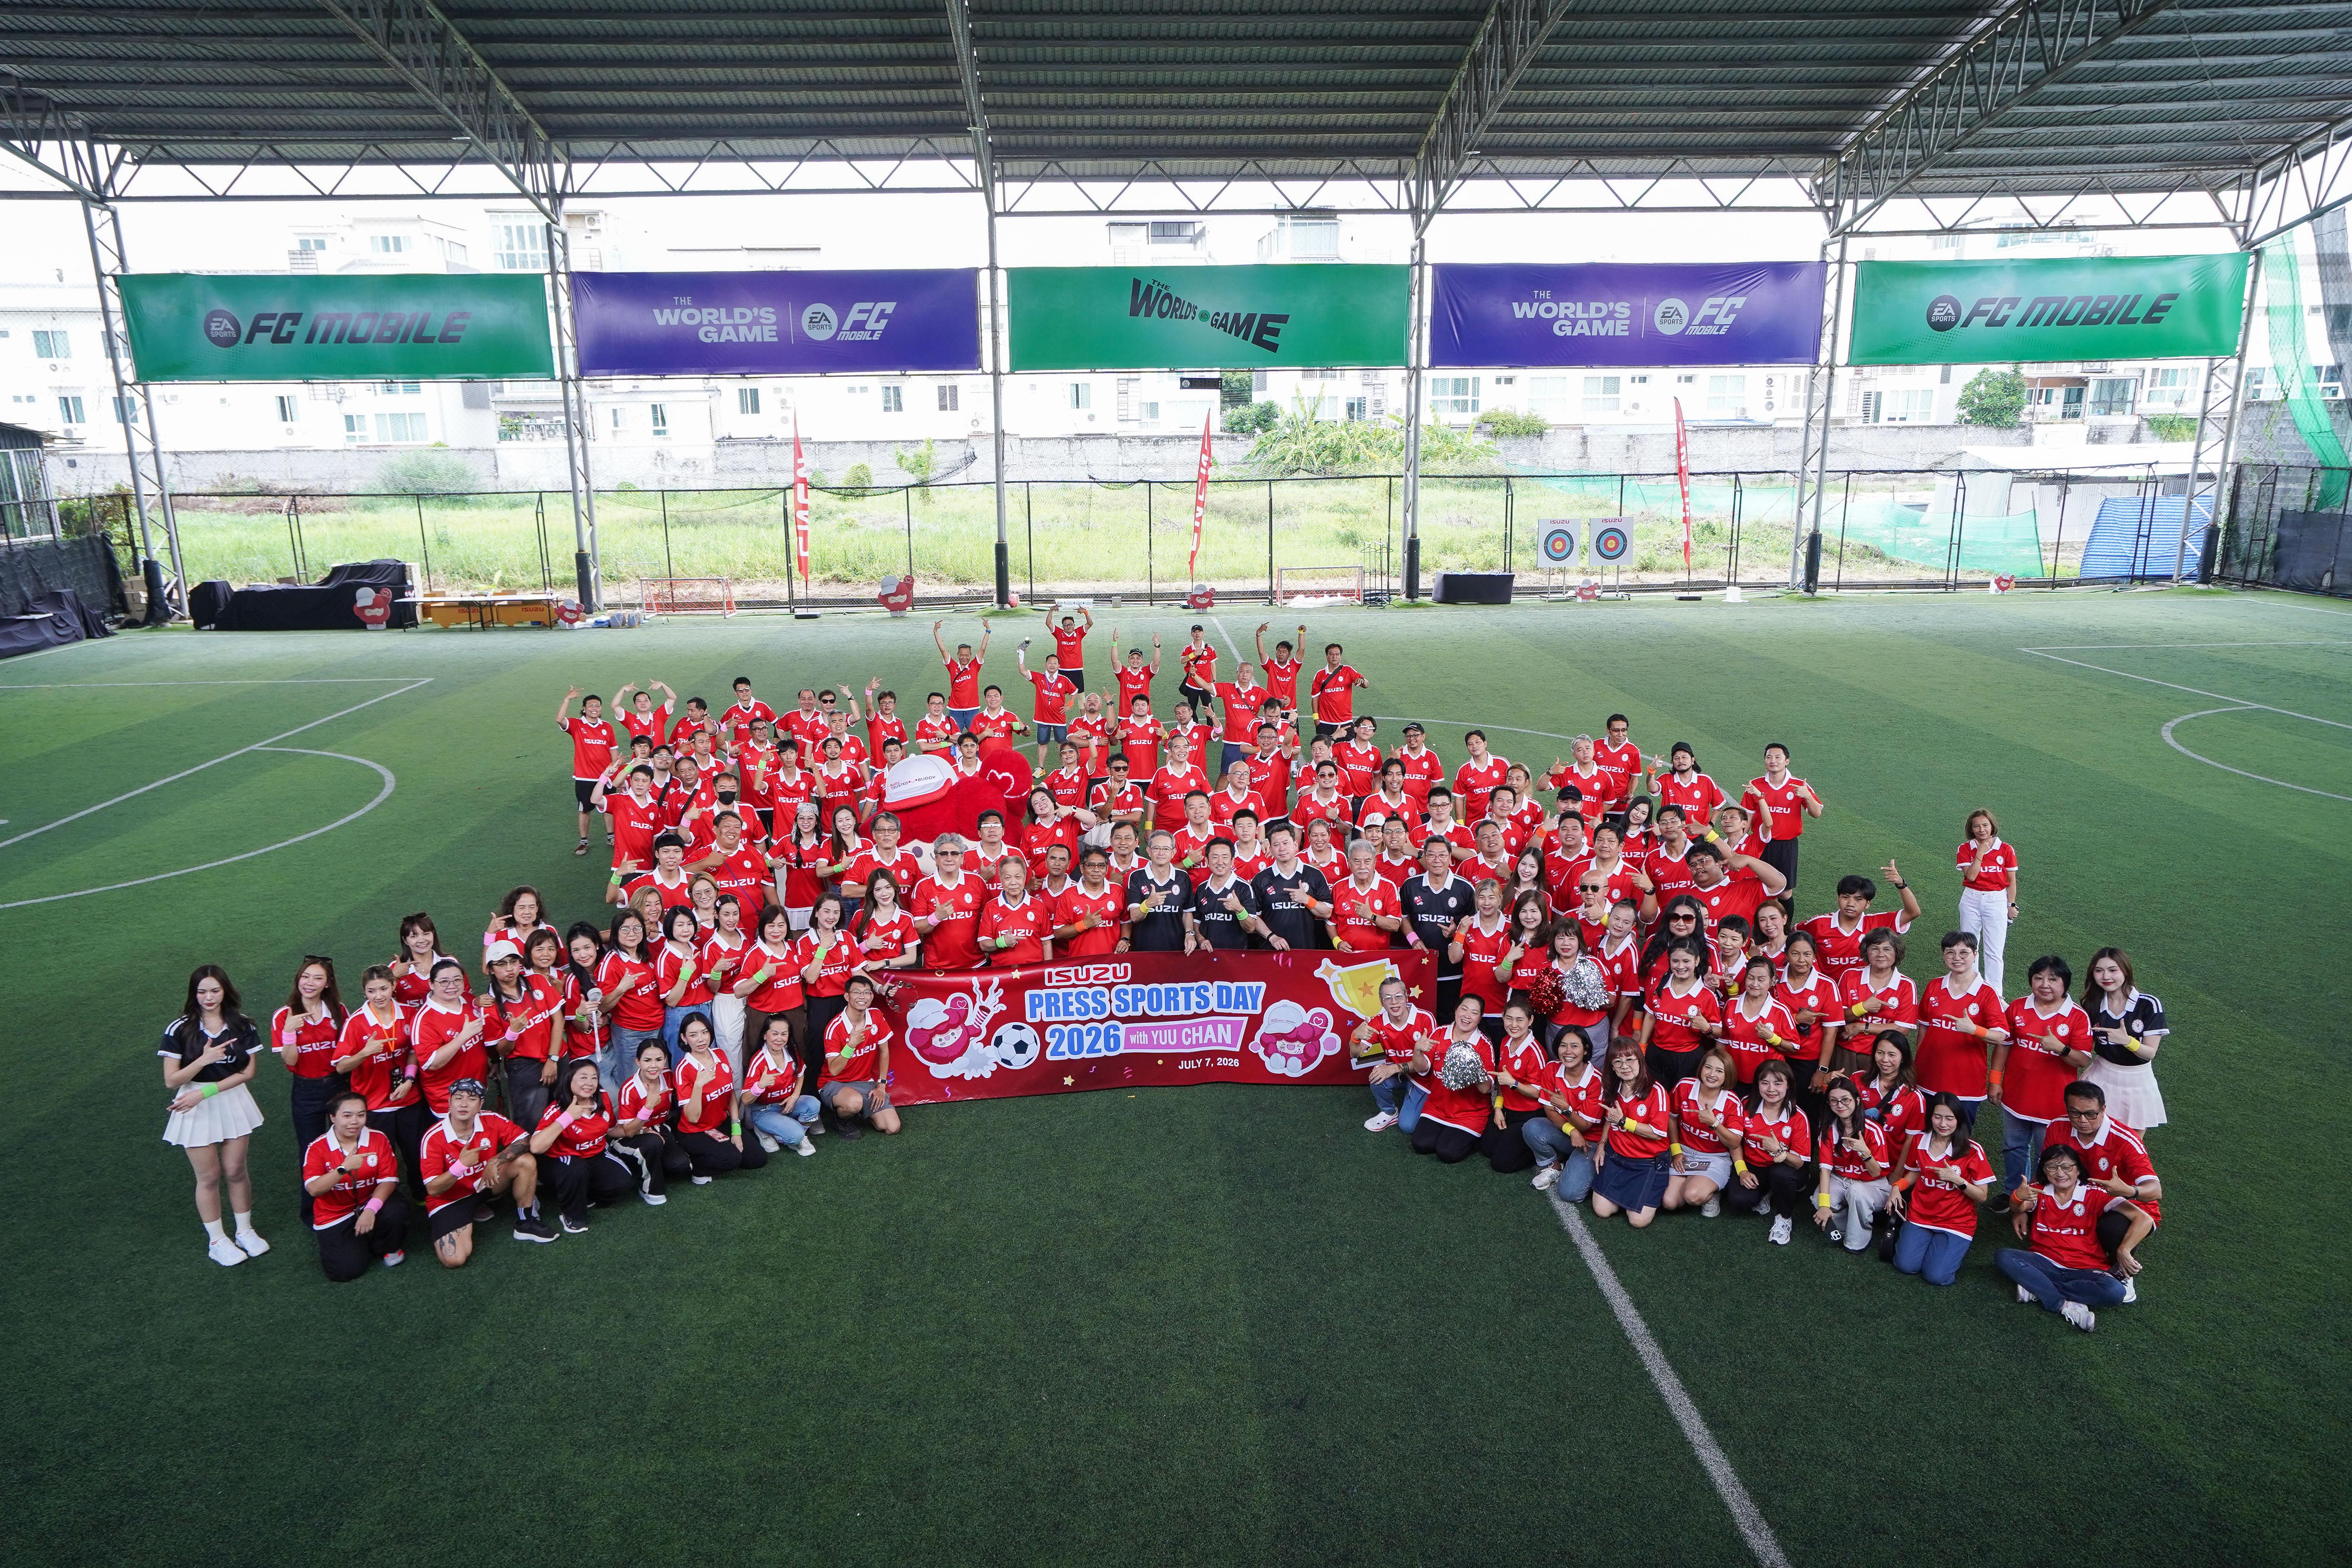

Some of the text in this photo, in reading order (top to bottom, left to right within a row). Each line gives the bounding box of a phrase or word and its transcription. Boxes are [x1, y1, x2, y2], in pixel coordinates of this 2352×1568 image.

[1151, 279, 1171, 291] THE
[674, 296, 692, 305] THE
[1534, 290, 1551, 299] THE
[1129, 277, 1290, 354] WORLD'S GAME
[1512, 302, 1630, 319] WORLD'S
[1661, 306, 1682, 318] EA
[1692, 297, 1747, 325] FC
[1932, 303, 1955, 315] EA
[1960, 293, 2180, 327] FC MOBILE
[653, 307, 777, 325] WORLD'S
[808, 311, 831, 324] EA
[841, 302, 897, 330] FC
[210, 318, 233, 331] EA
[244, 312, 473, 344] FC MOBILE
[1553, 320, 1629, 336] GAME
[1684, 325, 1730, 335] MOBILE
[698, 326, 778, 343] GAME
[836, 331, 883, 341] MOBILE
[1346, 764, 1372, 772] ISUZU
[891, 782, 908, 790] TRUSTED
[717, 878, 755, 887] ISUZU
[1469, 952, 1496, 963] ISUZ
[820, 965, 849, 977] SUZU
[1047, 965, 1130, 984] ISUZU
[773, 975, 801, 989] ISUZ
[1028, 985, 1263, 1019] PRESS SPORTS DAY
[1049, 1024, 1232, 1057] 2026 with YUU CHAN
[1178, 1057, 1240, 1070] JULY 7, 2026
